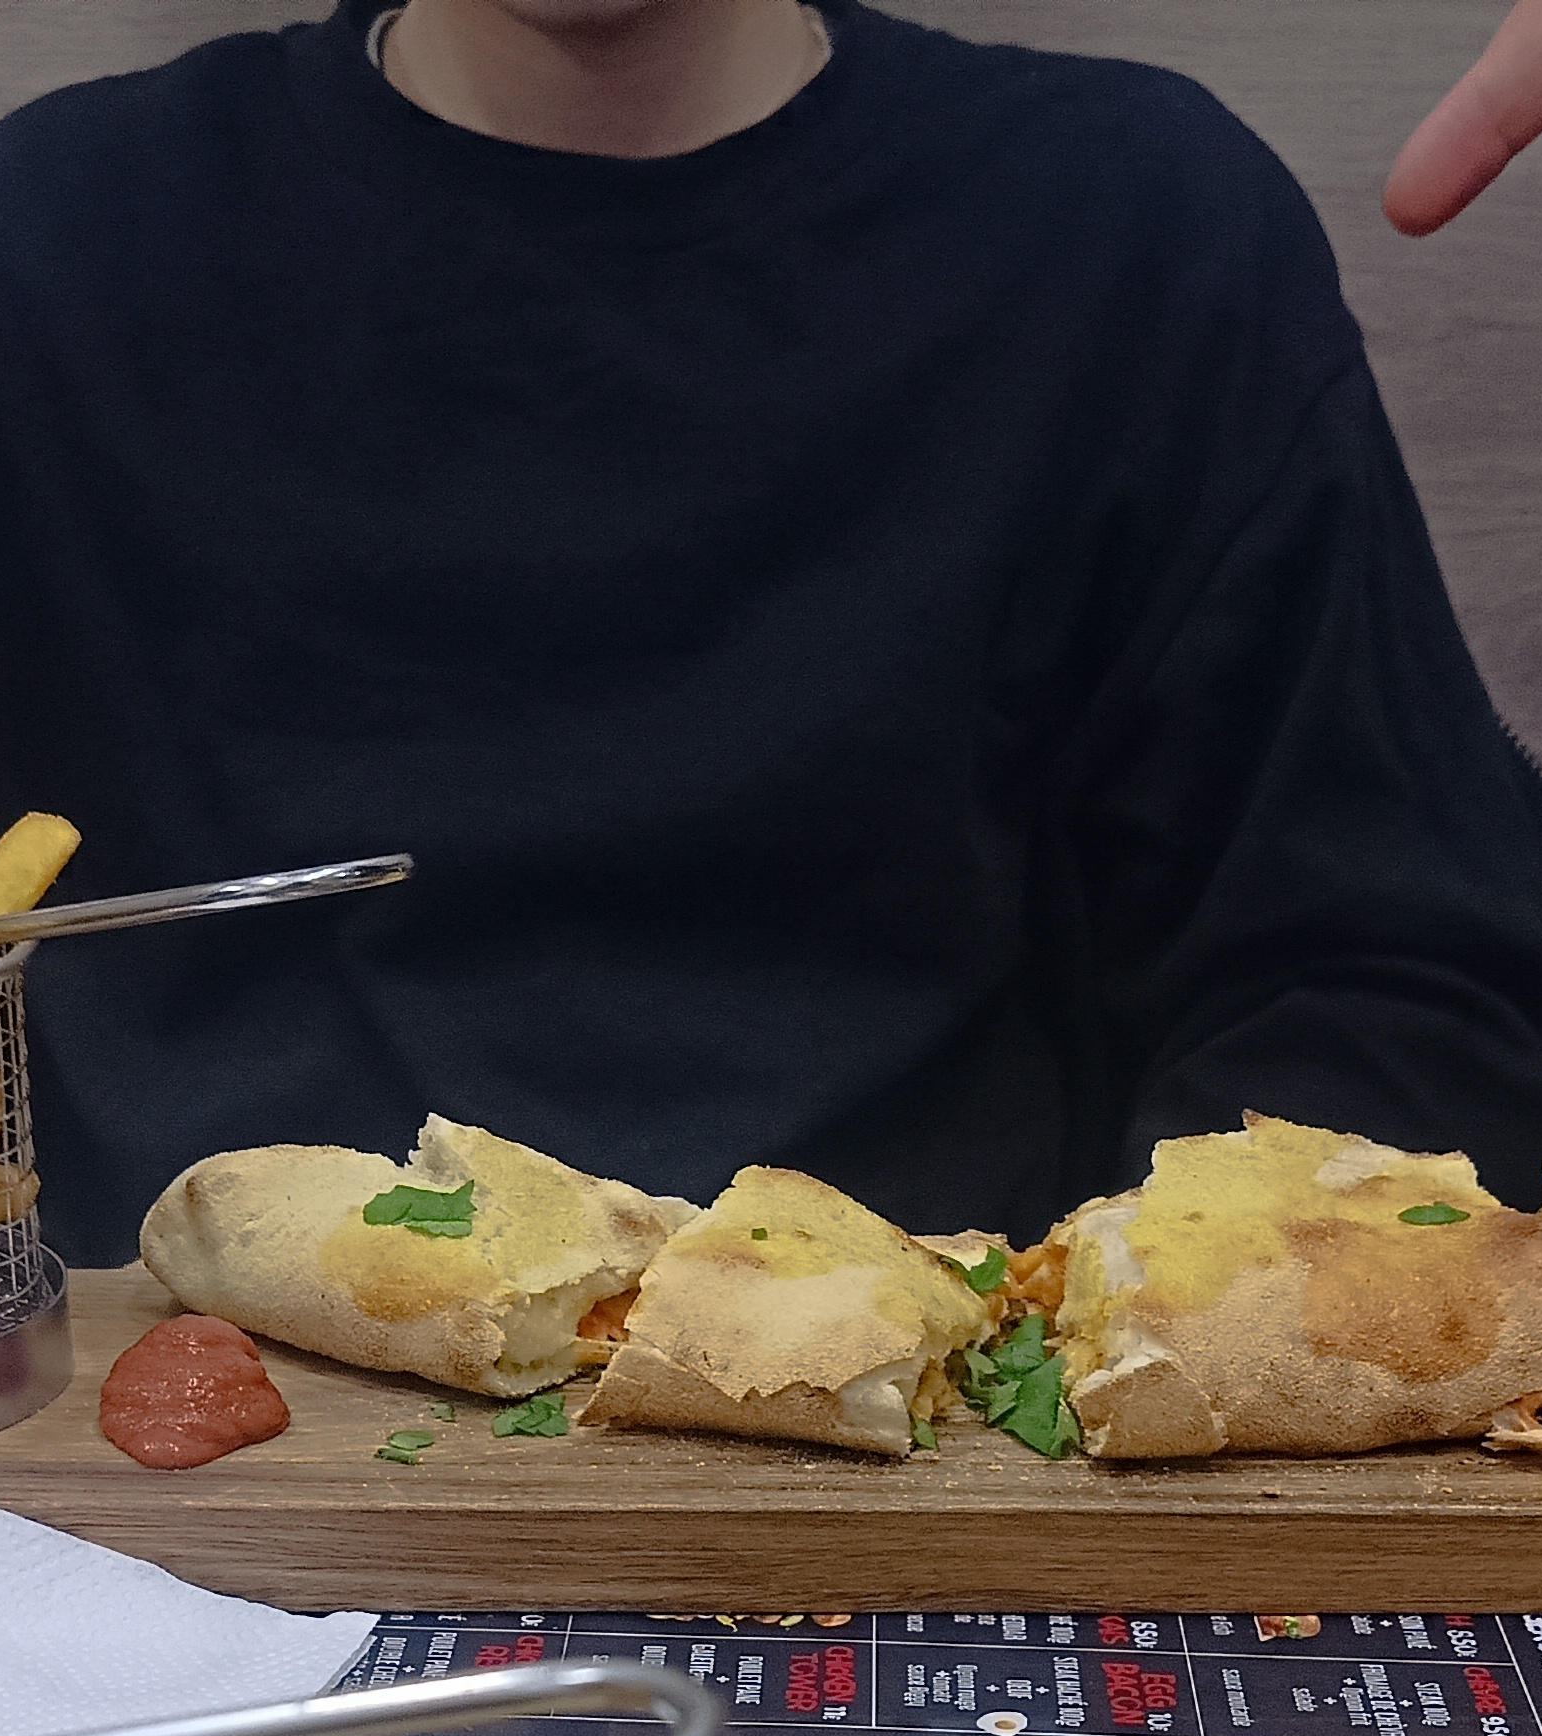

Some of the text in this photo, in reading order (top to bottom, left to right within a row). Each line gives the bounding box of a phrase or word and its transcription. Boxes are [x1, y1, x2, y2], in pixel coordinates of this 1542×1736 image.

[736, 1654, 764, 1684] POULET
[786, 1653, 820, 1712] TOWER
[1358, 1662, 1394, 1700] FROMAGE
[1053, 1679, 1089, 1727] HACHÉ 100g
[1102, 1661, 1148, 1726] BACON
[1138, 1670, 1177, 1708] EGG
[1225, 1689, 1255, 1727] moutarde
[1369, 1699, 1397, 1712] DE
[1420, 1706, 1451, 1727] 100g
